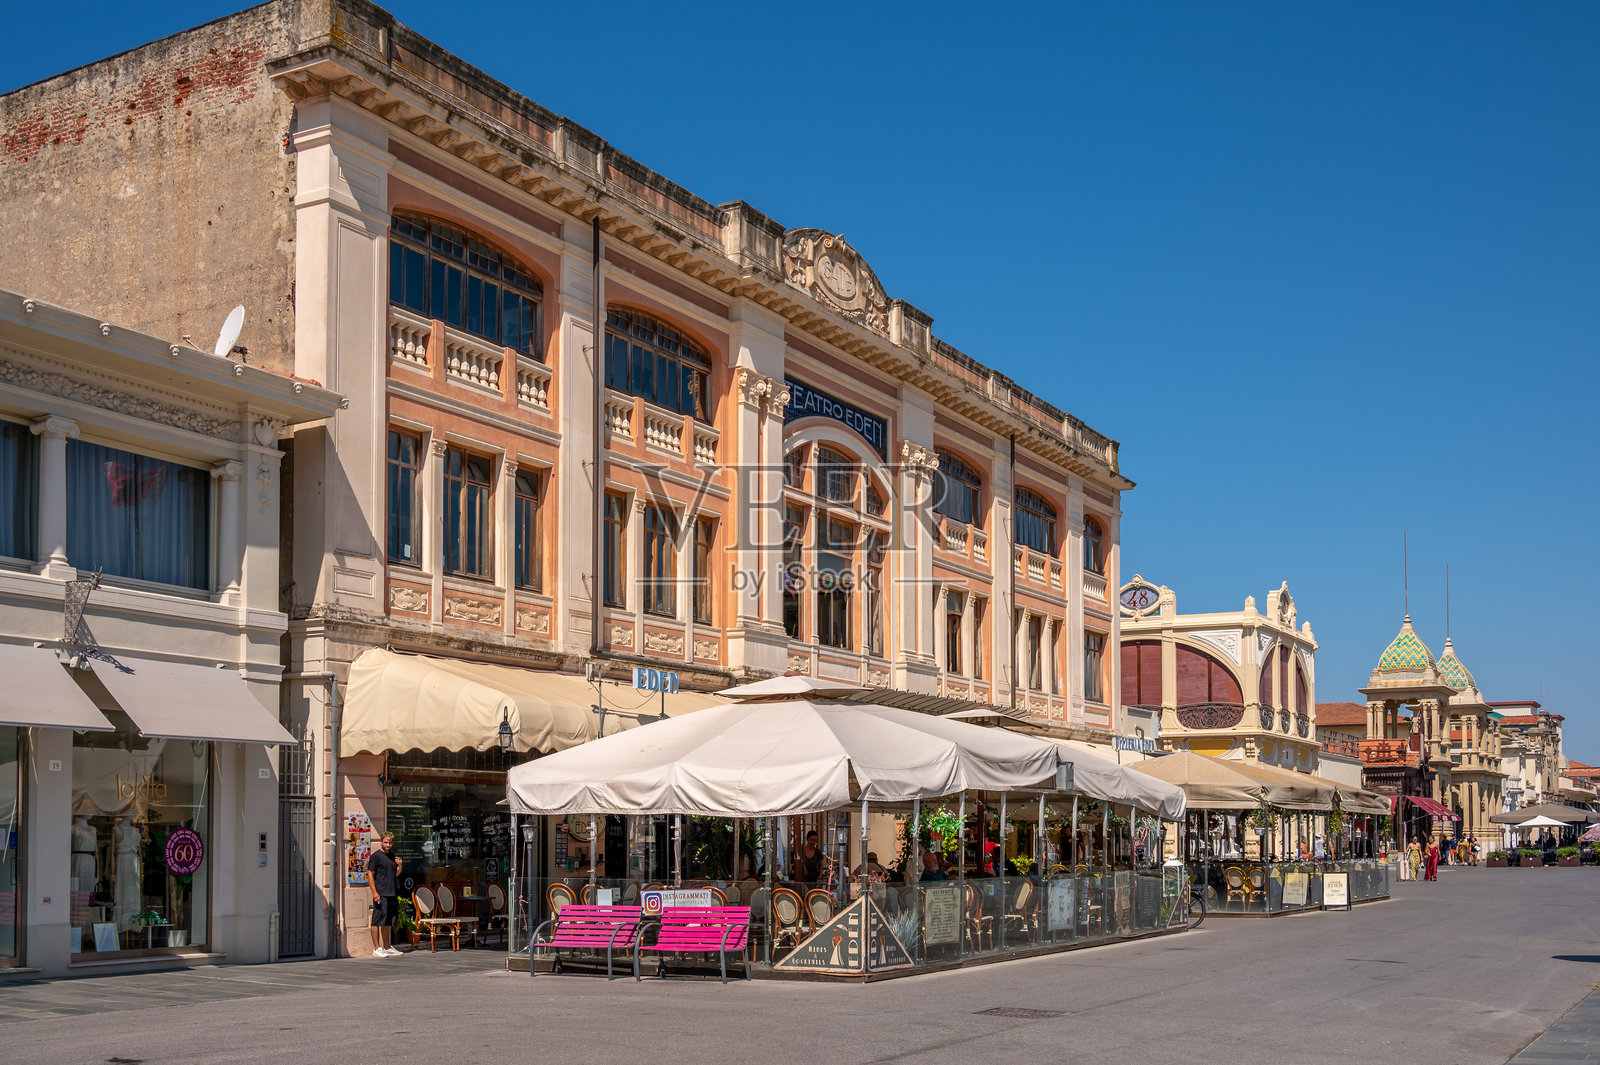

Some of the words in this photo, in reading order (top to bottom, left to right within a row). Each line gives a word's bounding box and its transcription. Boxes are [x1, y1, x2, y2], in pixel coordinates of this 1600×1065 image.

[785, 381, 843, 419] TEATRO
[845, 408, 882, 449] EDEN
[1126, 590, 1149, 607] 48
[637, 667, 679, 694] EDEN
[53, 761, 60, 770] 19
[117, 773, 167, 804] lokita
[175, 845, 194, 861] 60
[663, 892, 709, 900] INSTAGRAMMATI
[848, 912, 859, 967] EDEN
[791, 957, 826, 965] COCKTAILS
